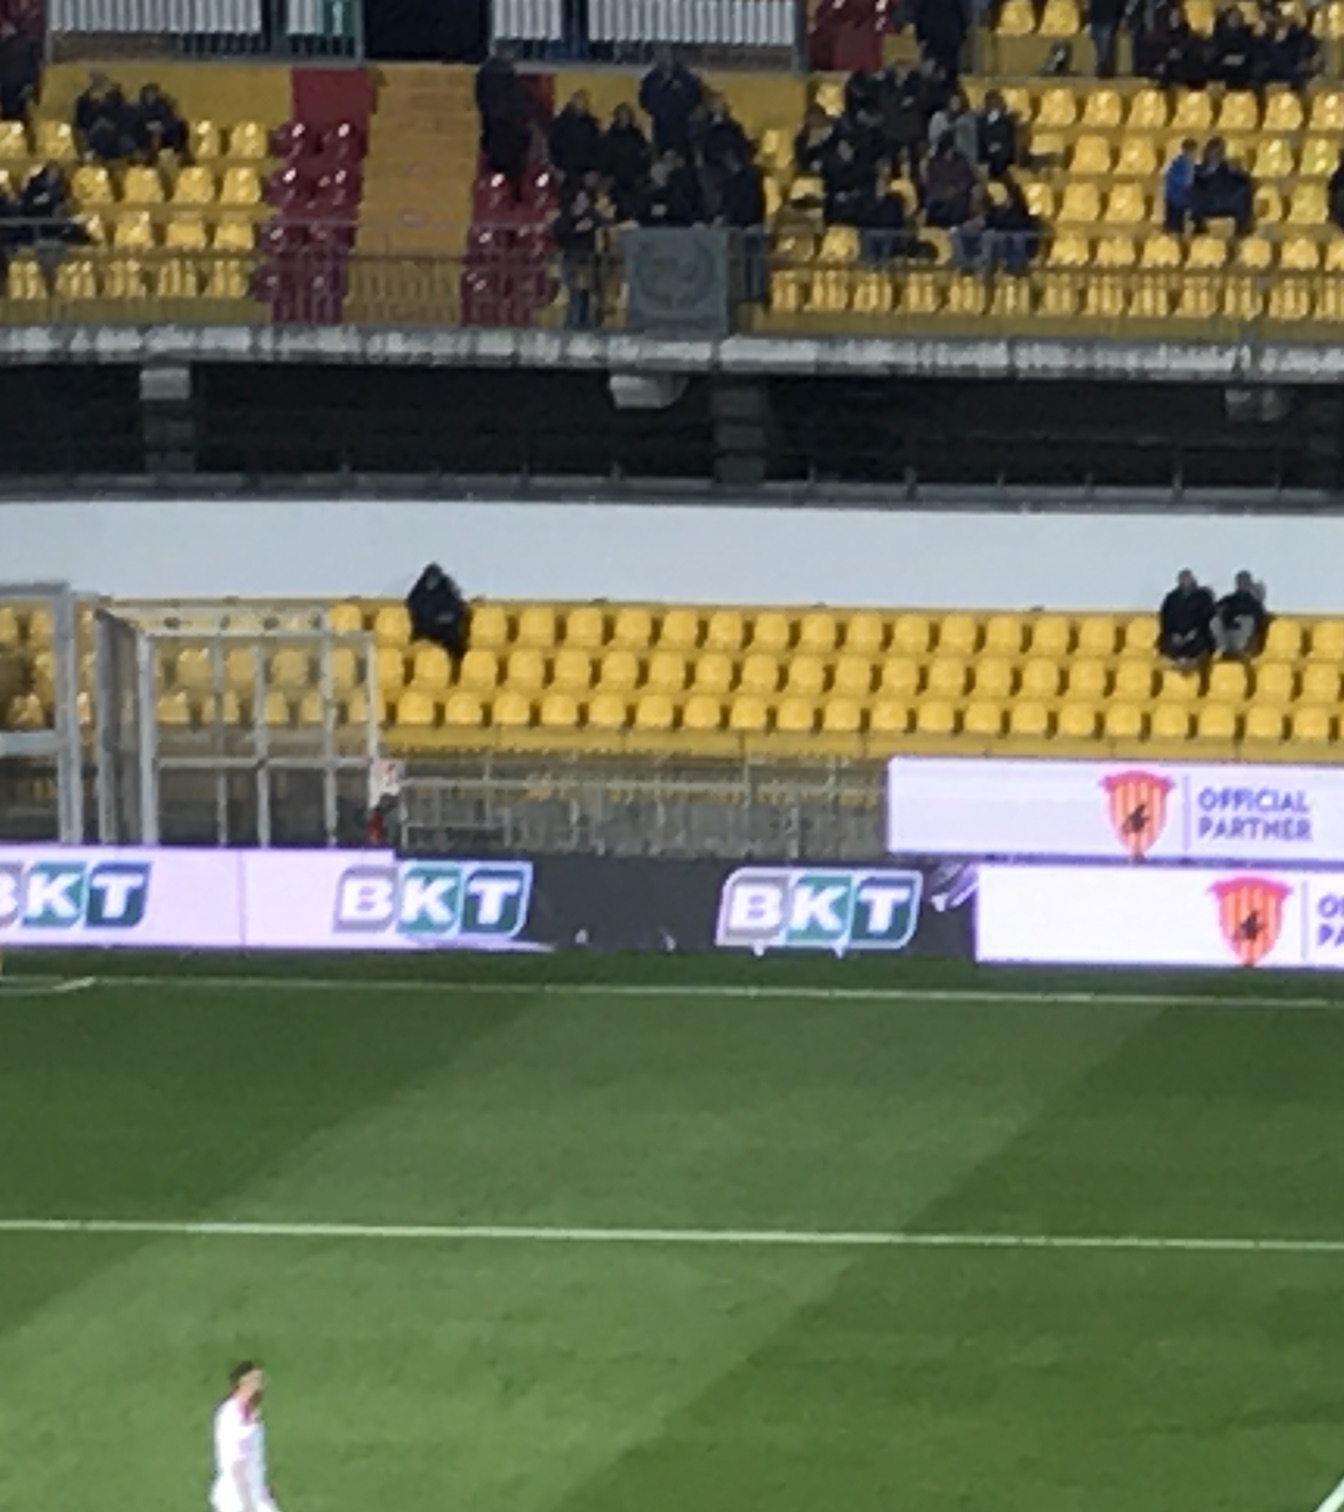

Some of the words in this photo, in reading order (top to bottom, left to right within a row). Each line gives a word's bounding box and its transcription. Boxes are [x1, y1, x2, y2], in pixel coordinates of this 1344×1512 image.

[1198, 787, 1310, 813] OFFICIAL
[1198, 816, 1312, 842] PARTNER
[338, 876, 522, 926] BKT
[728, 882, 912, 932] BKT
